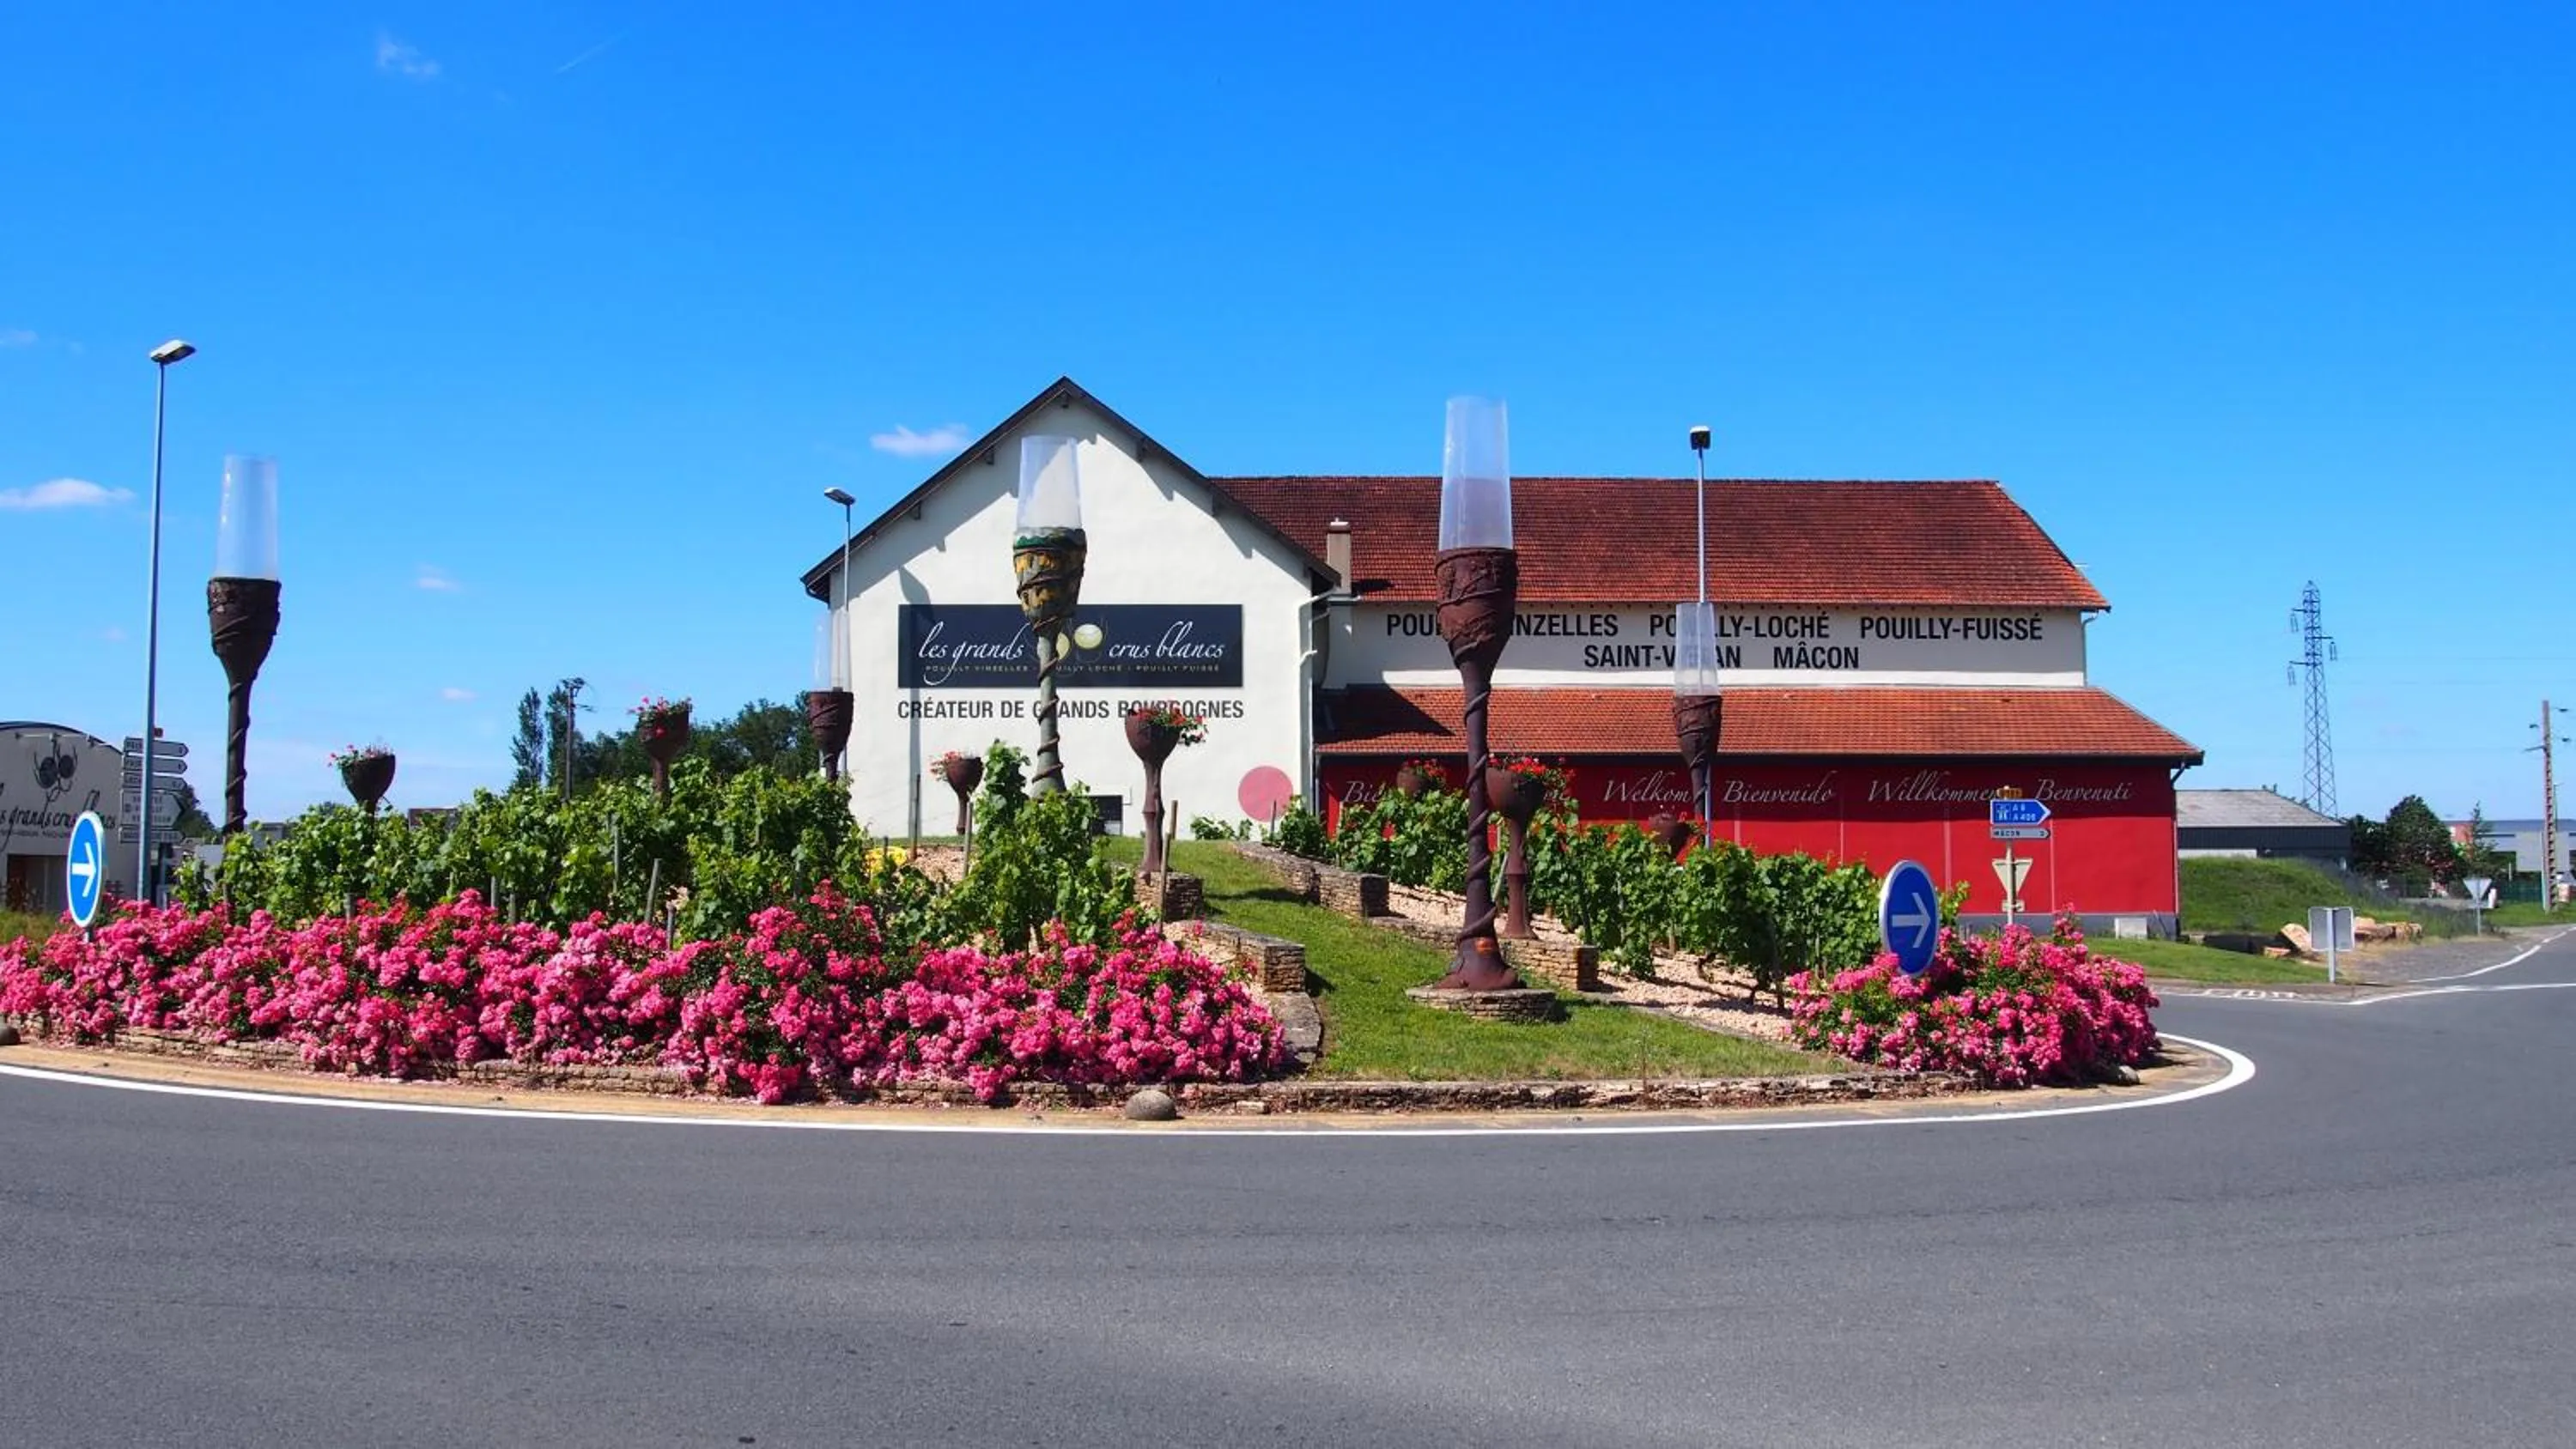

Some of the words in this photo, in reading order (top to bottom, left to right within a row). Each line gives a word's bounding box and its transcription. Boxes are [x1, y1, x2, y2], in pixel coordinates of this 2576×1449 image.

[918, 621, 948, 658] les
[1155, 621, 1226, 659] blancs
[1860, 612, 2043, 640] POUILLY-FUISSÉ
[924, 621, 1030, 686] grands
[1109, 643, 1151, 659] crus
[1583, 645, 1742, 669] SAINT-VAN
[1772, 640, 1860, 669] MÂCON
[897, 696, 994, 718] CRÉATEUR
[1000, 700, 1024, 718] DE
[1032, 700, 1110, 719] GANDS
[1602, 770, 1693, 802] Welkom
[1722, 769, 1835, 803] Bienvenido
[2033, 777, 2133, 802] Benvenuti
